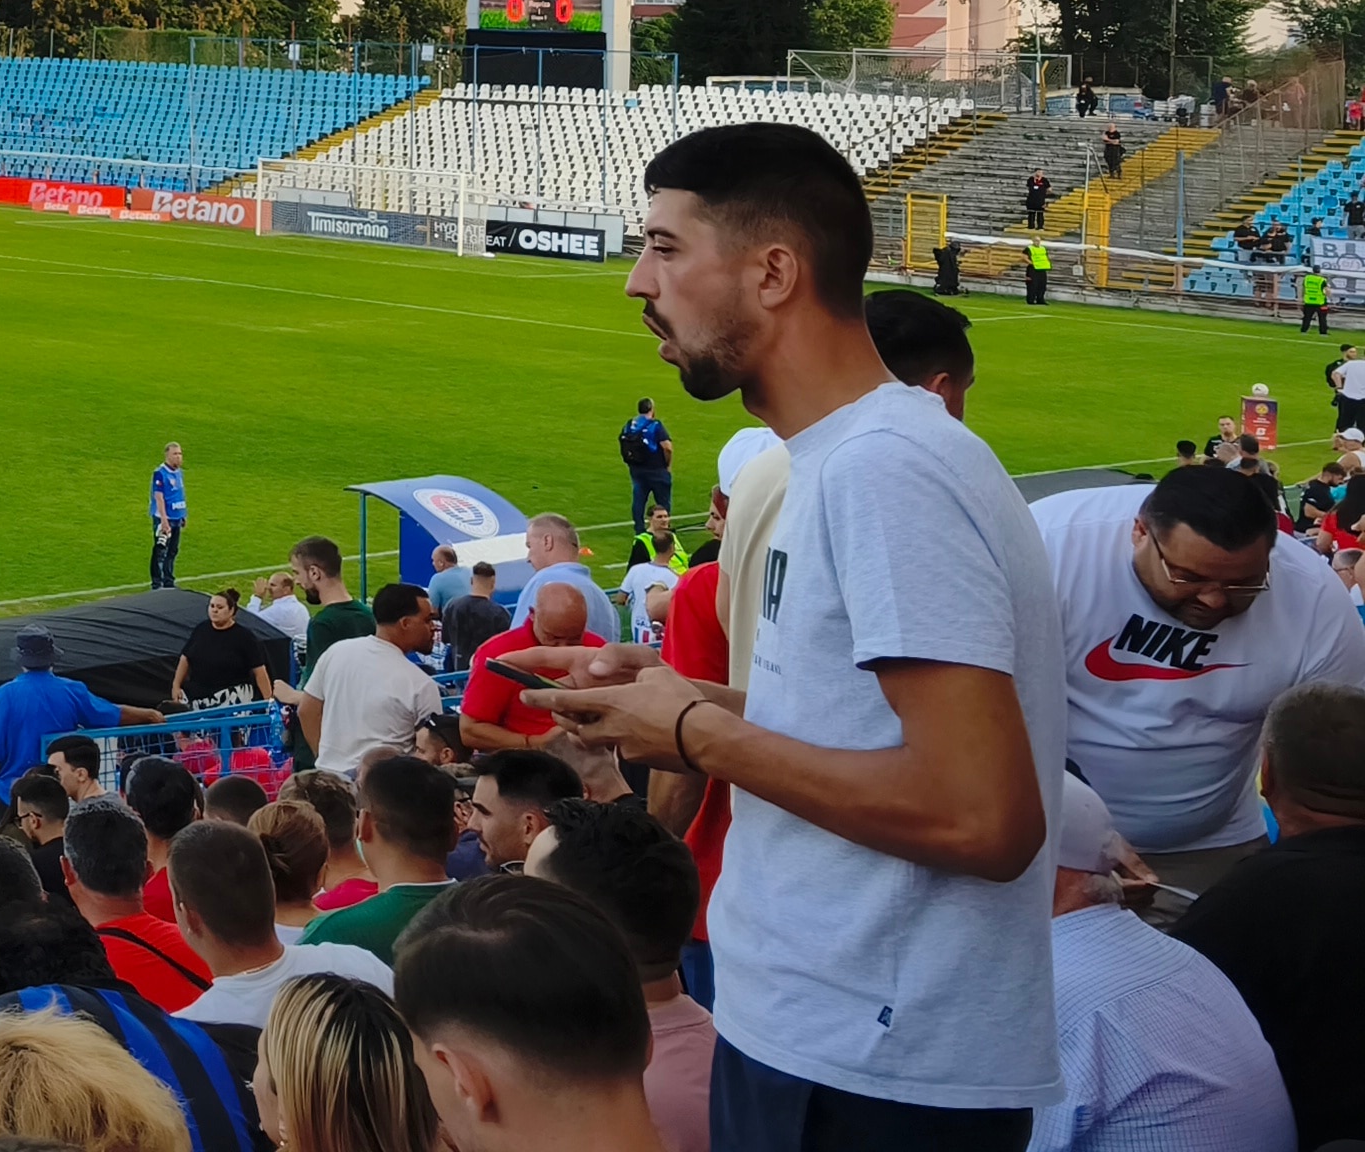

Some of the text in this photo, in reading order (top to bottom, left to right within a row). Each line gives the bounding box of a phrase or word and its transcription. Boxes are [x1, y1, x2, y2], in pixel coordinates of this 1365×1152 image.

[28, 182, 103, 207] Betano
[77, 205, 111, 215] Betan
[119, 210, 161, 221] Betano
[152, 190, 245, 225] Betano
[434, 221, 486, 236] HYDATE
[519, 228, 599, 256] OSHEE
[1113, 613, 1219, 671] NIKE
